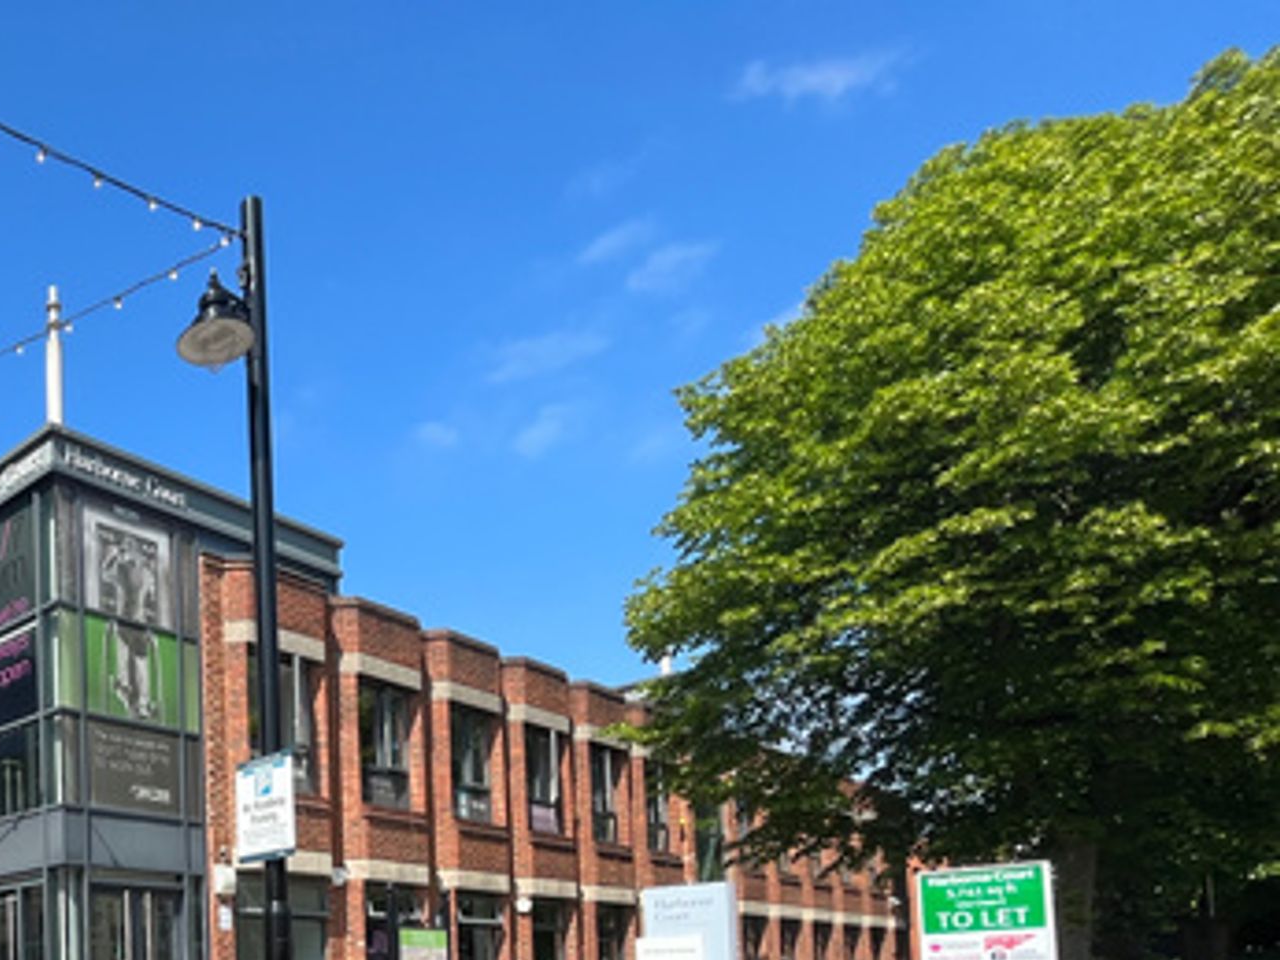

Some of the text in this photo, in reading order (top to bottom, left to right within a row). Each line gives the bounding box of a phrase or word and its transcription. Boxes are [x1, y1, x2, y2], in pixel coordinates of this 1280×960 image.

[993, 870, 1035, 883] Court
[936, 905, 1029, 929] TO LET
